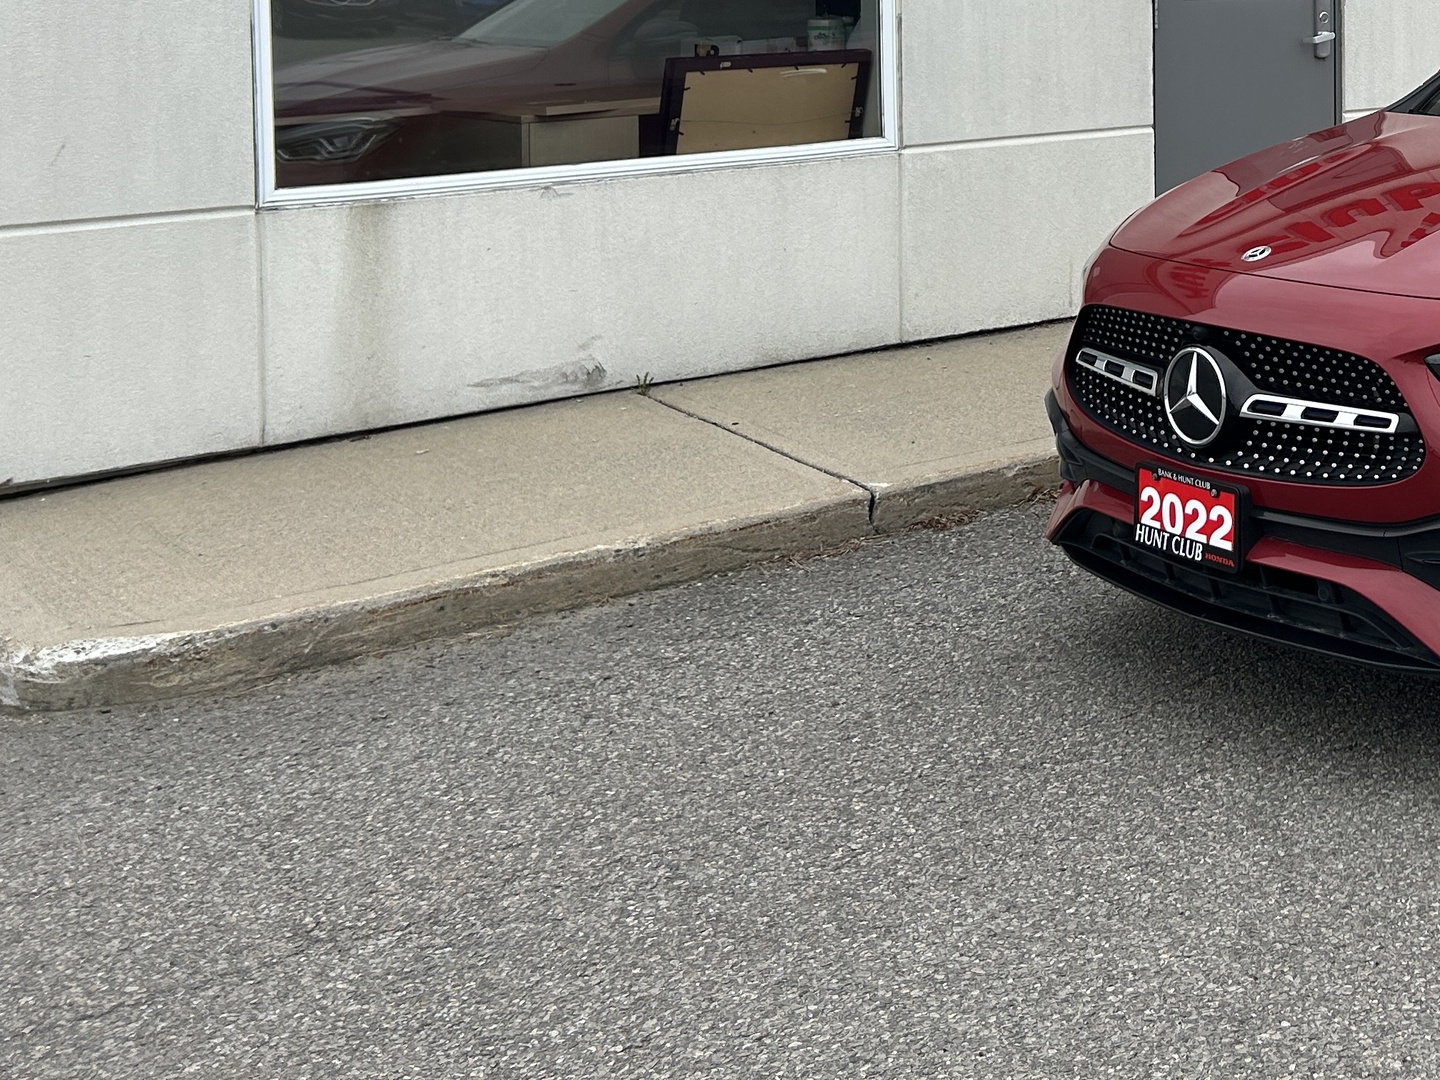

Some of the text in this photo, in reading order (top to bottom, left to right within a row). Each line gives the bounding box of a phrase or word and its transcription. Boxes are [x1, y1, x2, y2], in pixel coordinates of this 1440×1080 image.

[1158, 468, 1172, 479] BANK
[1178, 474, 1194, 485] HUNT
[1195, 479, 1211, 489] CLUB
[1140, 486, 1233, 552] 2022
[1135, 523, 1203, 561] HUNT CLUB
[1205, 553, 1235, 567] HONDA
